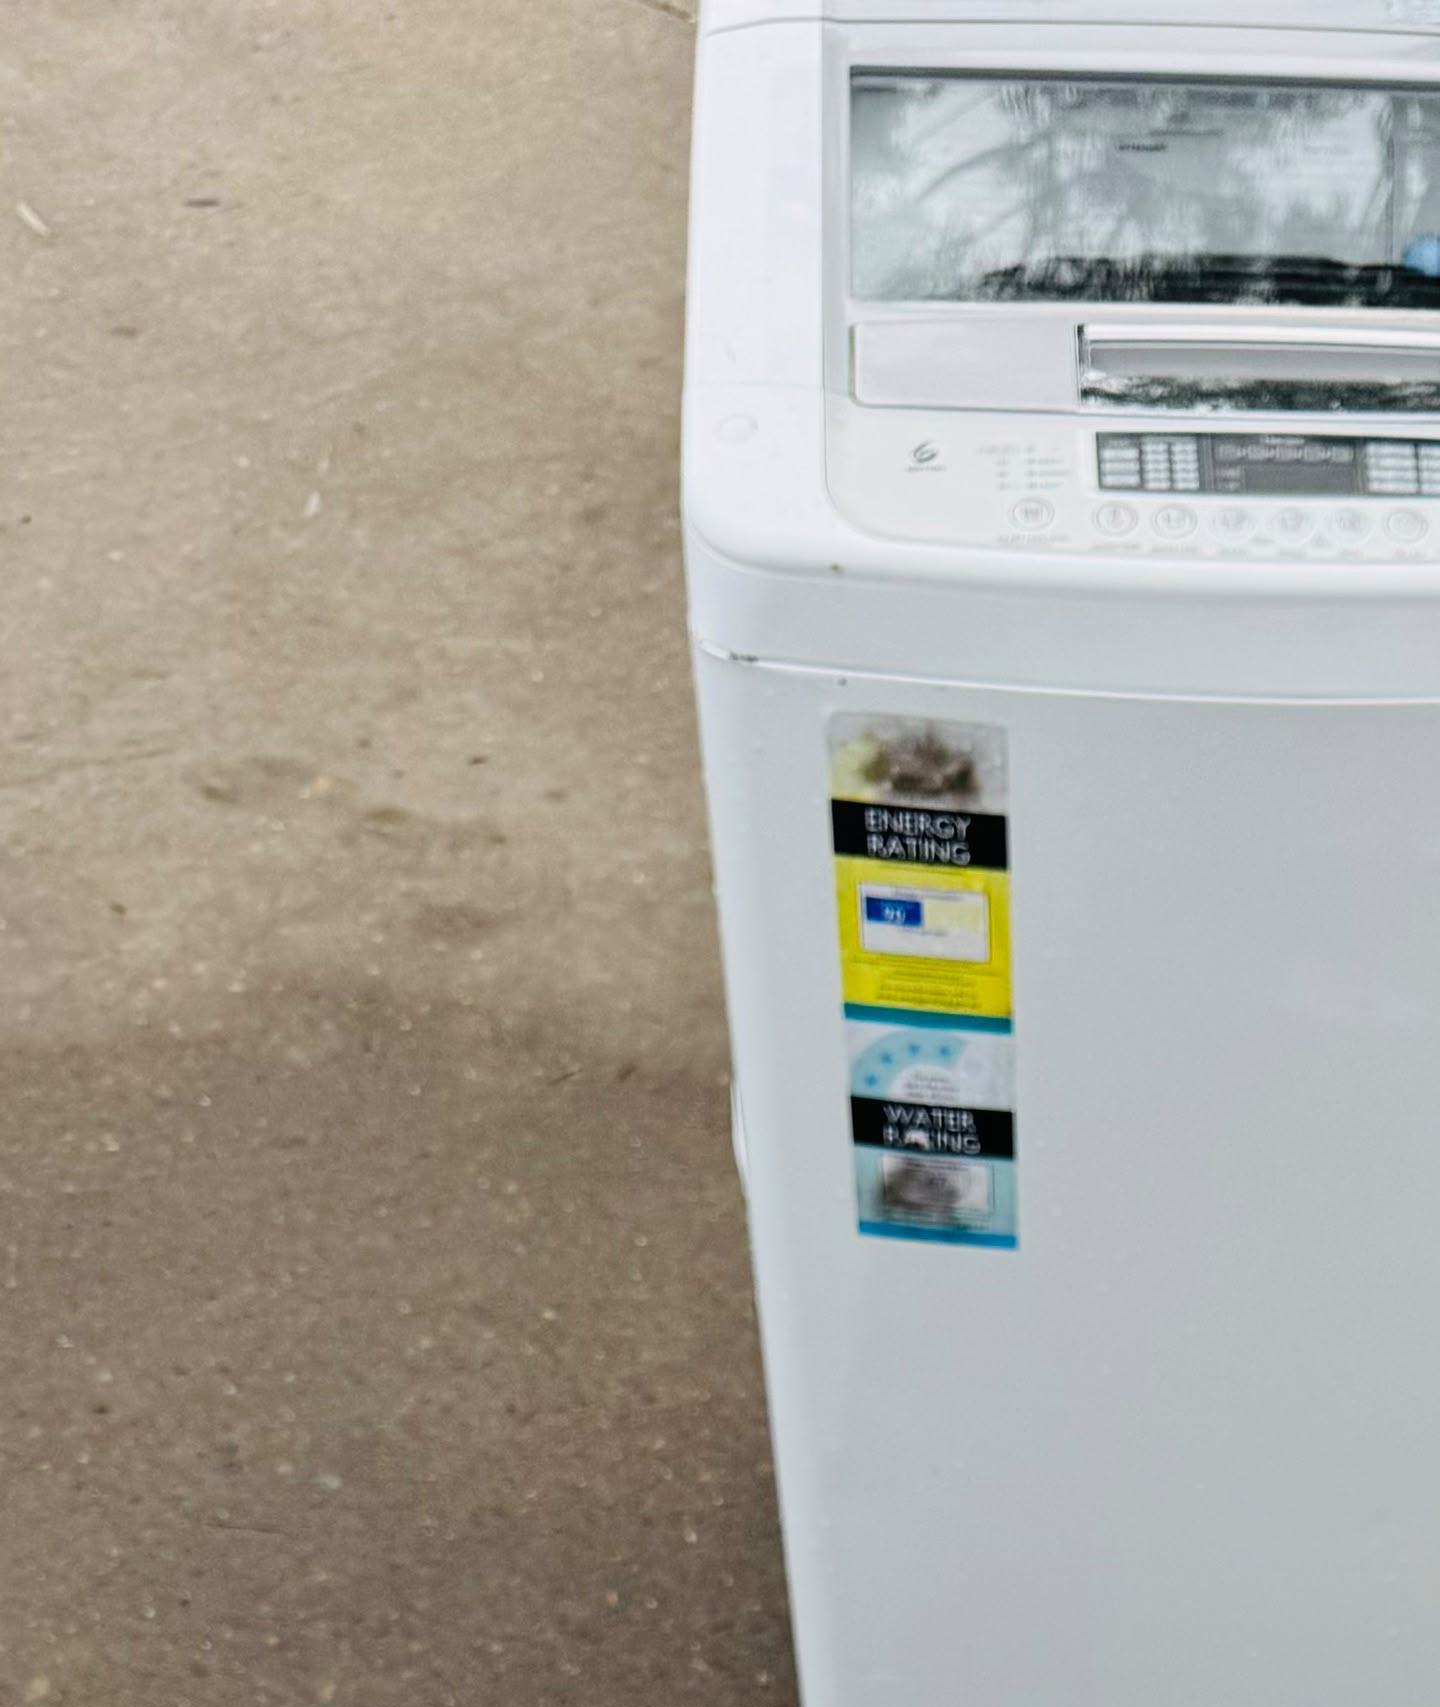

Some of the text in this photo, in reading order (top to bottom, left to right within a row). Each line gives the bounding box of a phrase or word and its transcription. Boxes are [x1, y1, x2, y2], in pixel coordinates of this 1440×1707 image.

[864, 807, 971, 840] ENERGY
[866, 832, 971, 866] RATING
[882, 1104, 977, 1132] WATER
[882, 1125, 981, 1154] RING
